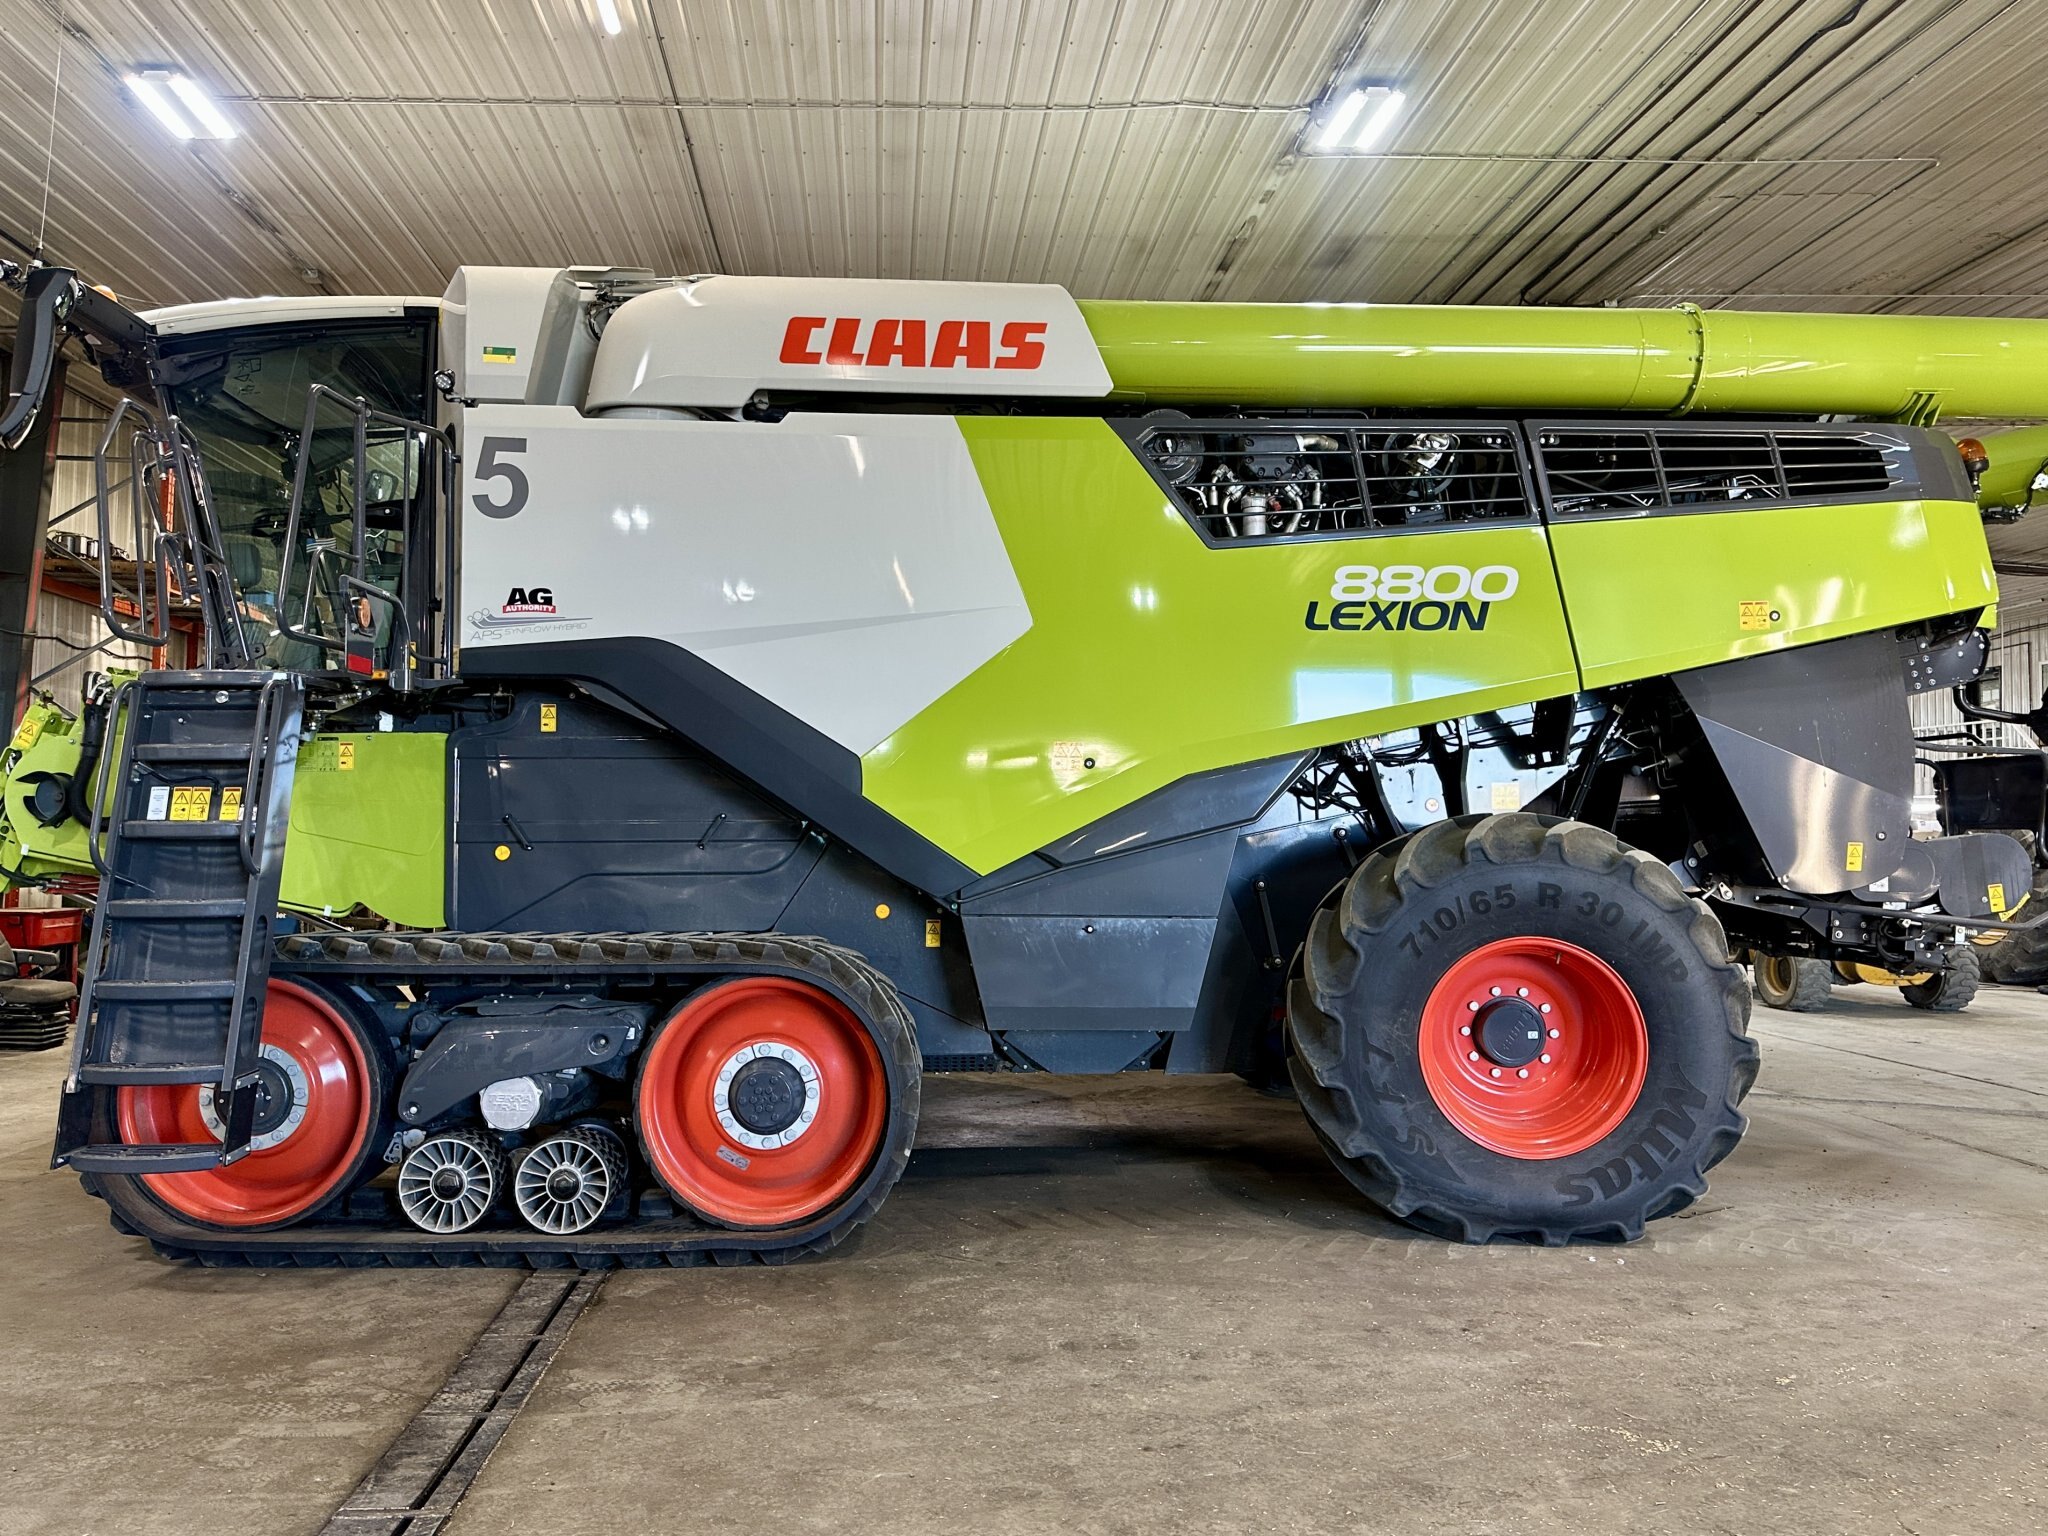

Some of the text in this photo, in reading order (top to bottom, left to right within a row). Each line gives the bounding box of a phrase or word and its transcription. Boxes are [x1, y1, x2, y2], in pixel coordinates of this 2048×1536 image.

[779, 316, 1048, 370] CLAAS
[472, 436, 529, 519] 5
[506, 588, 553, 606] AG
[1330, 565, 1519, 601] 8800
[505, 603, 553, 612] AUTHORITY
[1304, 601, 1490, 631] LEXION
[470, 622, 587, 641] APS SYNFLOW HYBRID
[1398, 881, 1689, 982] 710/65 R 30 IMP
[488, 1093, 532, 1103] TERRA
[492, 1102, 529, 1111] TRAC
[1552, 1062, 1708, 1207] Mitas
